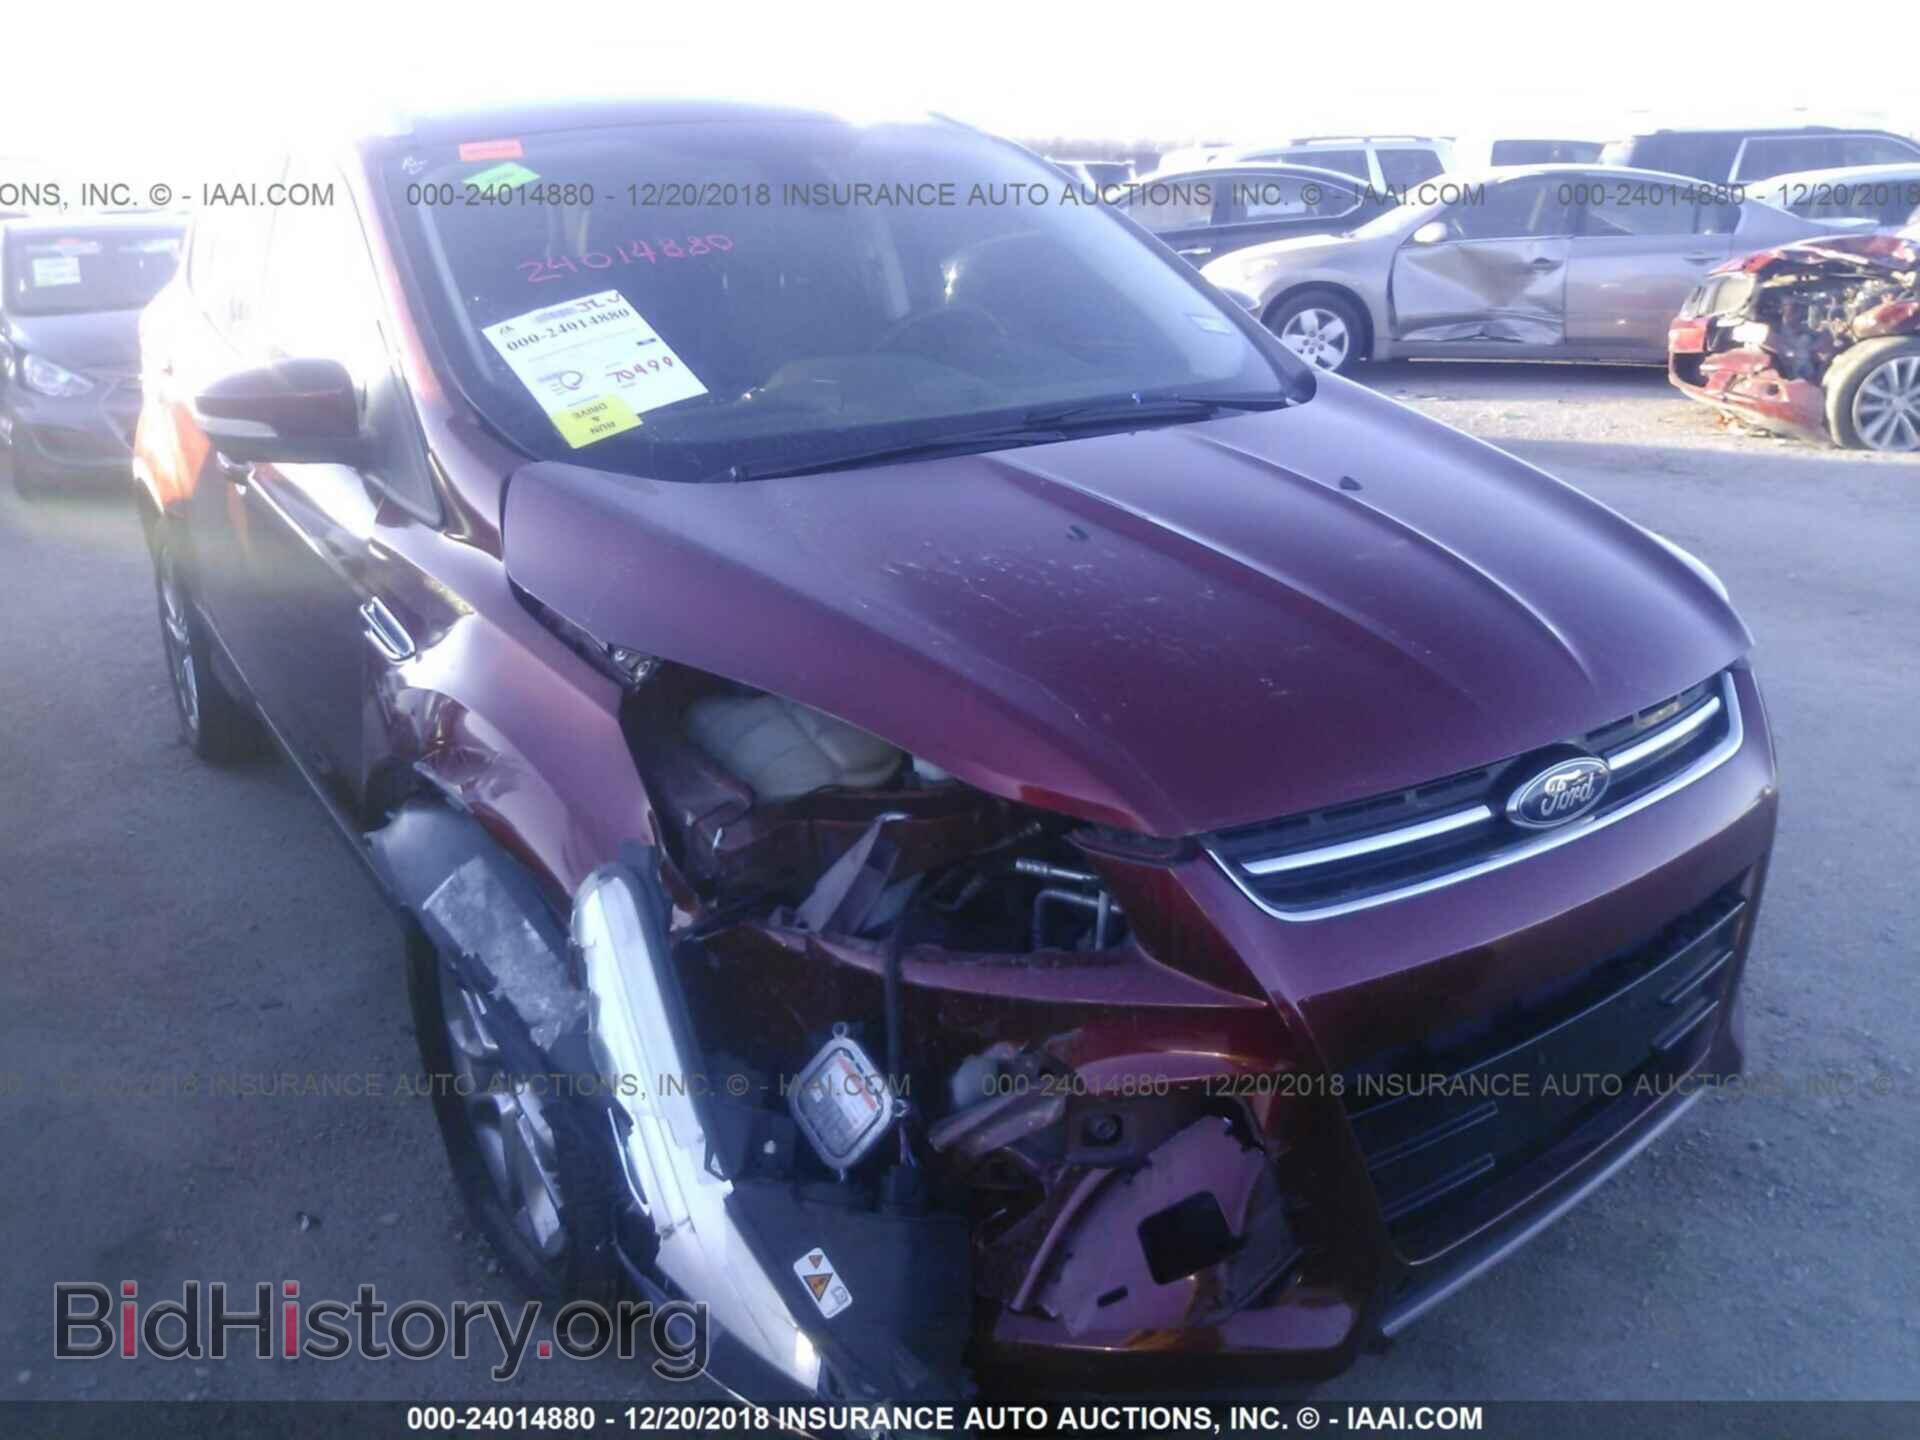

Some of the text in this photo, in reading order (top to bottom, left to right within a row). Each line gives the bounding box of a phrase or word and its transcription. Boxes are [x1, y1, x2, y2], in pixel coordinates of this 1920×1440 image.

[518, 234, 733, 283] 24014880
[506, 307, 631, 352] 000-24014880
[1540, 768, 1595, 816] Ford
